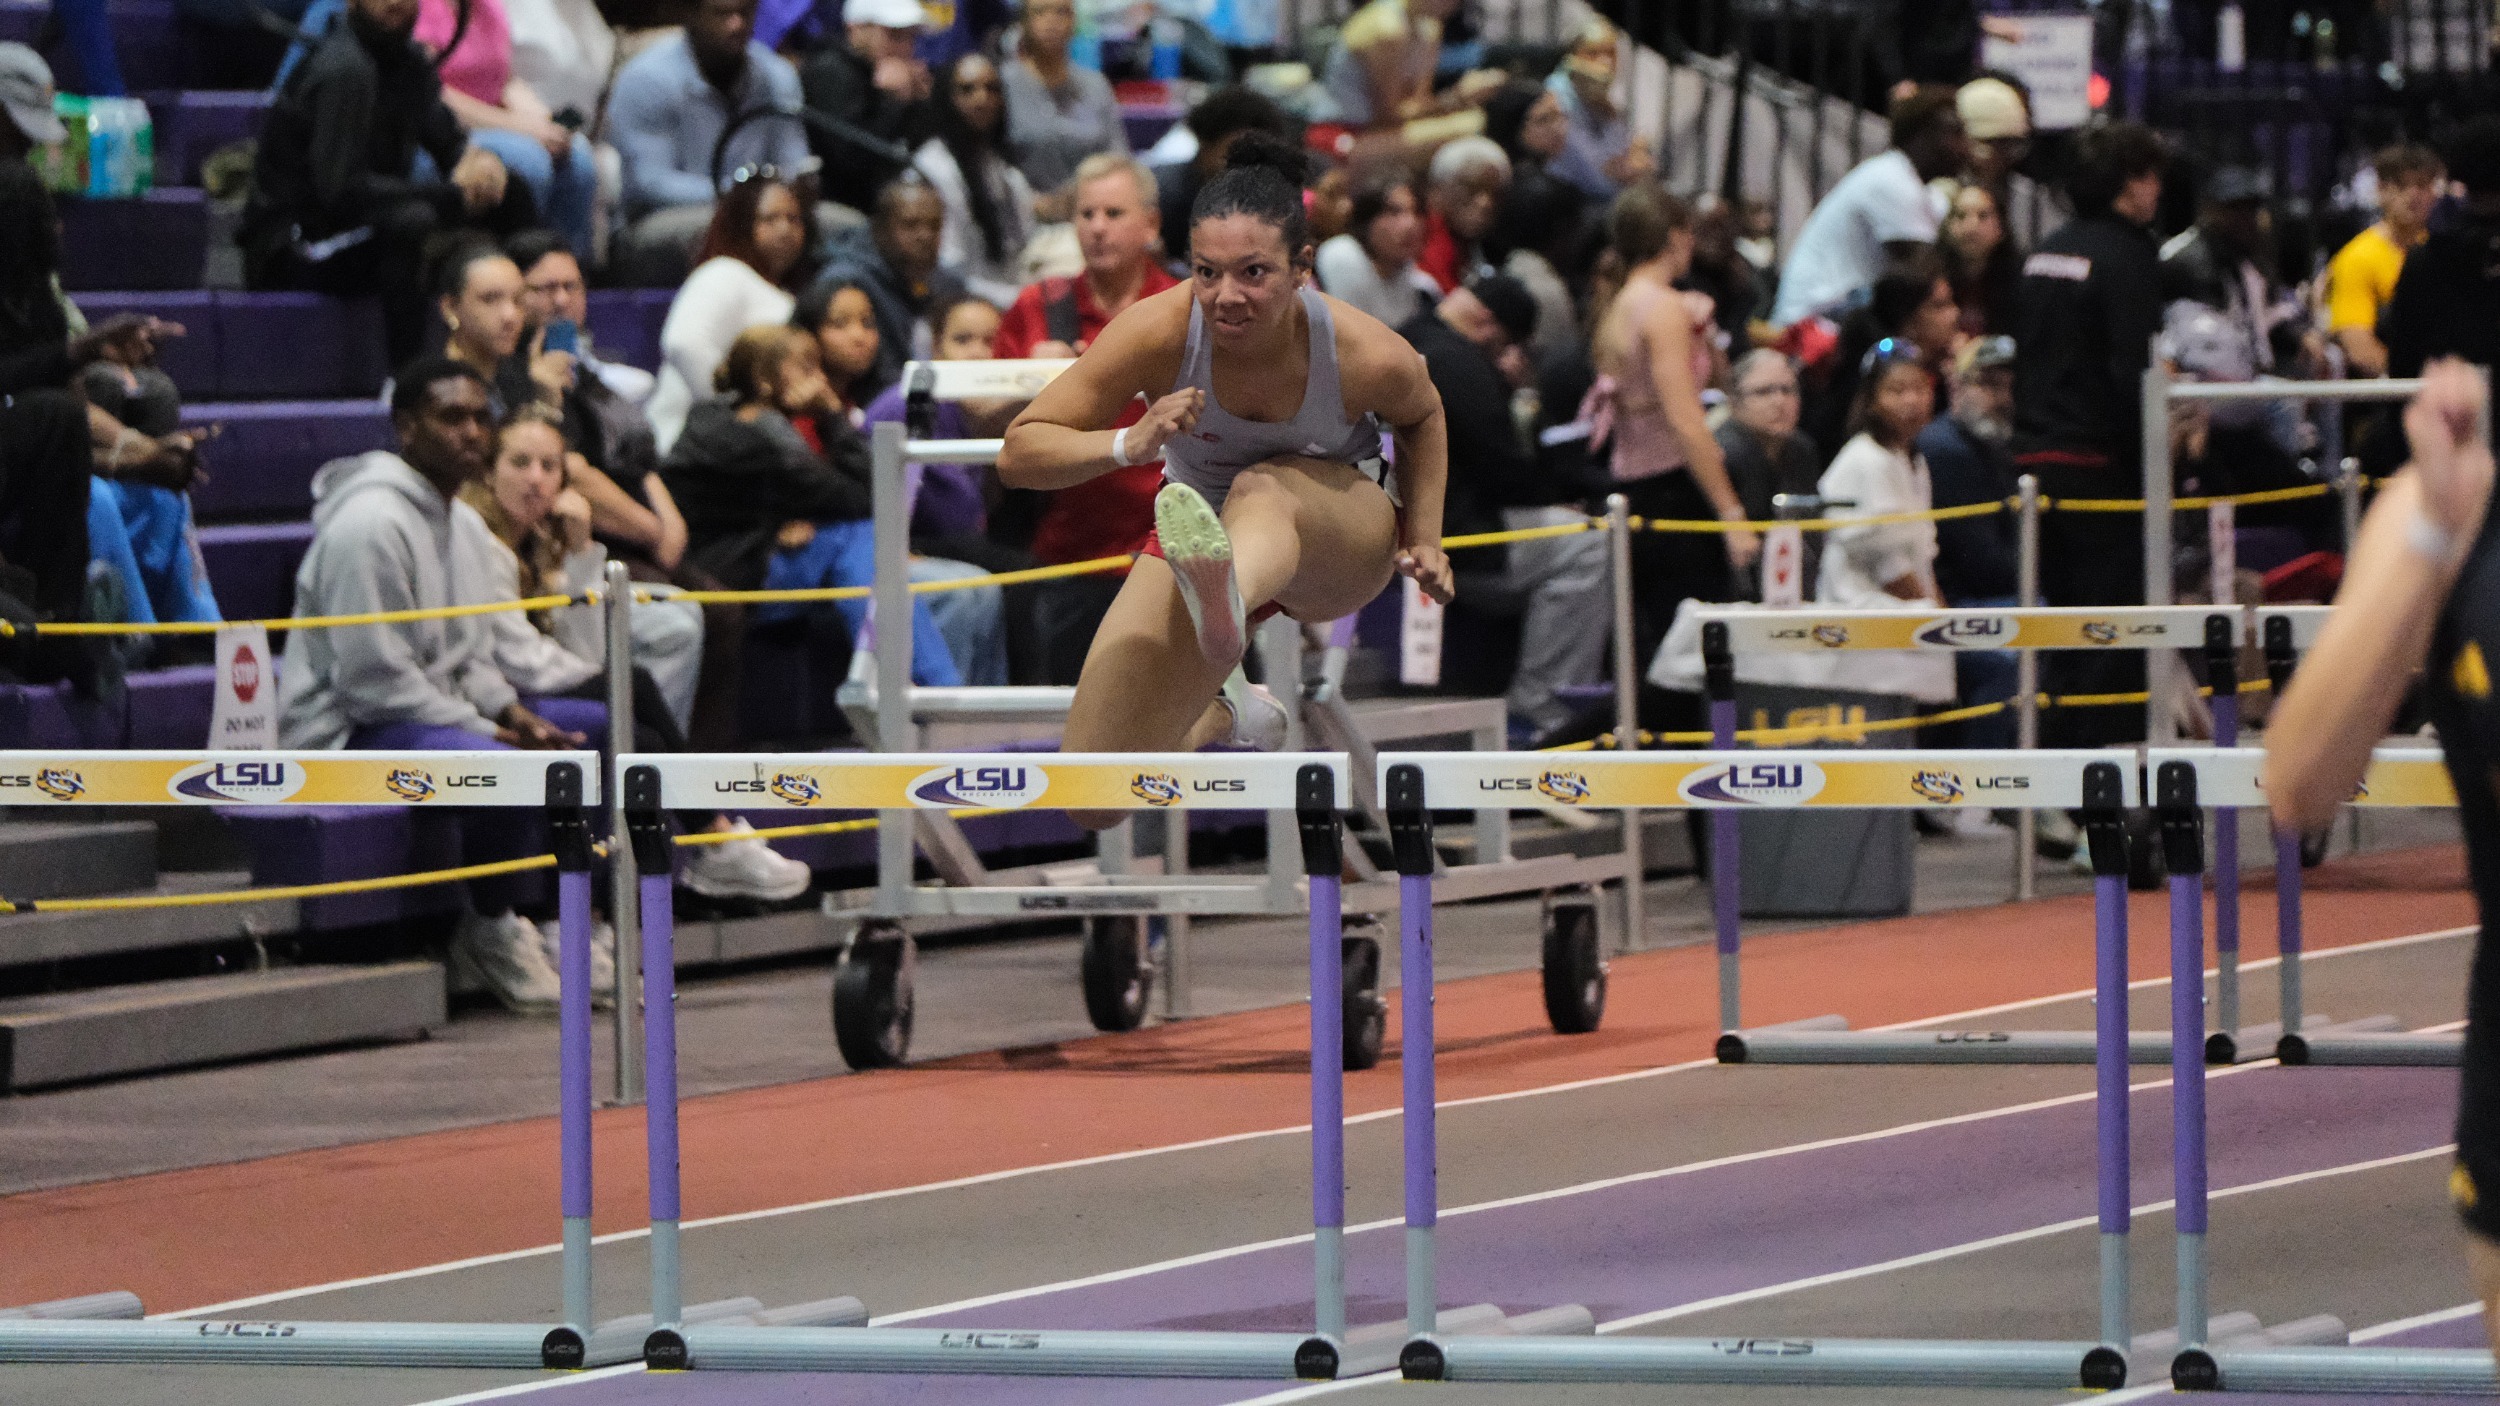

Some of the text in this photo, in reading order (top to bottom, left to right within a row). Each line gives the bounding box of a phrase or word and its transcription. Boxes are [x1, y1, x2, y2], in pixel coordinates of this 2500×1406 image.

[1950, 618, 2002, 635] LSU
[216, 763, 284, 785] LSU
[956, 768, 1026, 790] LSU
[1729, 765, 1802, 787] LSU
[447, 775, 497, 787] UCS
[715, 781, 766, 792] UCS
[1193, 780, 1246, 792] UCS
[1479, 778, 1532, 790] UCS
[1976, 776, 2030, 788] UCS
[1937, 1031, 2009, 1042] UCS
[941, 1333, 1040, 1349] UCS
